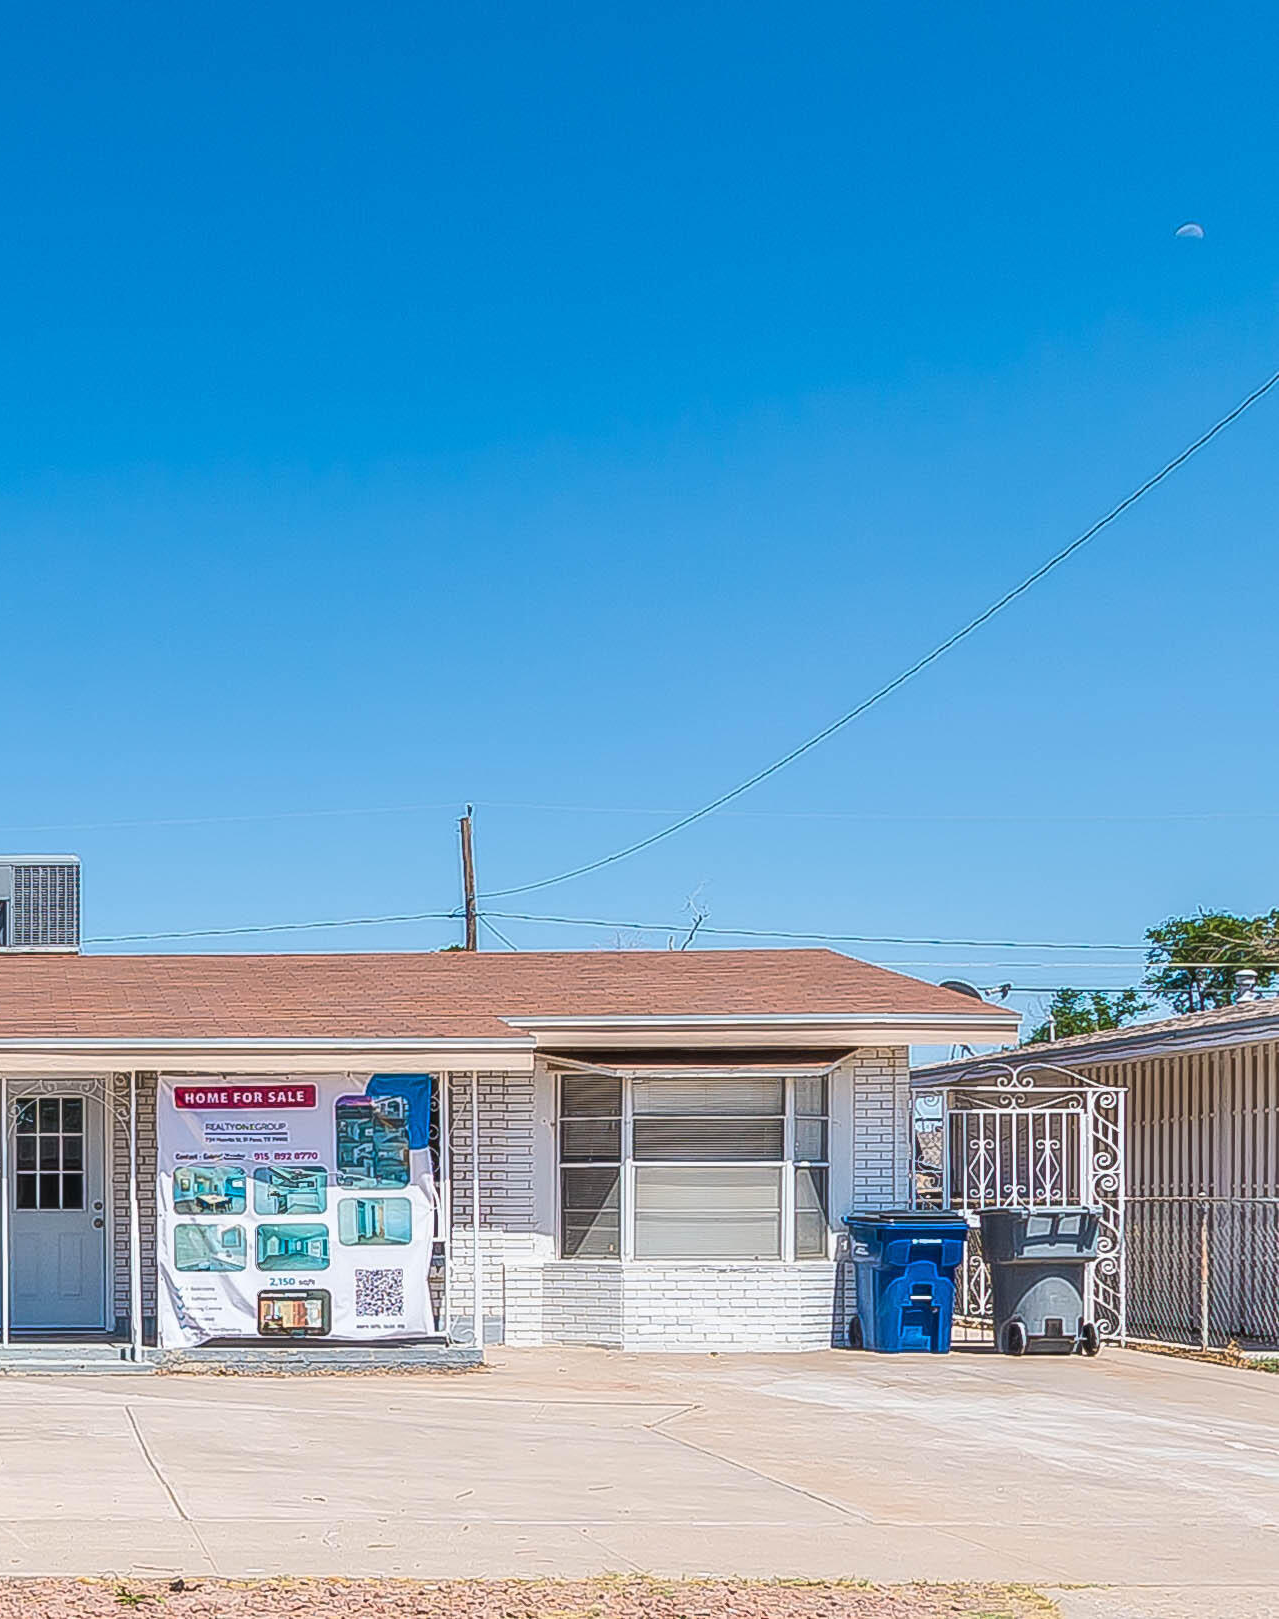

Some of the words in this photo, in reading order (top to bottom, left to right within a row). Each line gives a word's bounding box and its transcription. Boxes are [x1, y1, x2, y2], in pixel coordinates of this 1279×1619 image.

[185, 1093, 228, 1104] HOME
[233, 1092, 263, 1103] FOR
[268, 1091, 305, 1103] SALE
[254, 1152, 270, 1160] 915
[274, 1152, 292, 1160] 892
[294, 1152, 318, 1160] 8770
[269, 1278, 295, 1286] 2,150
